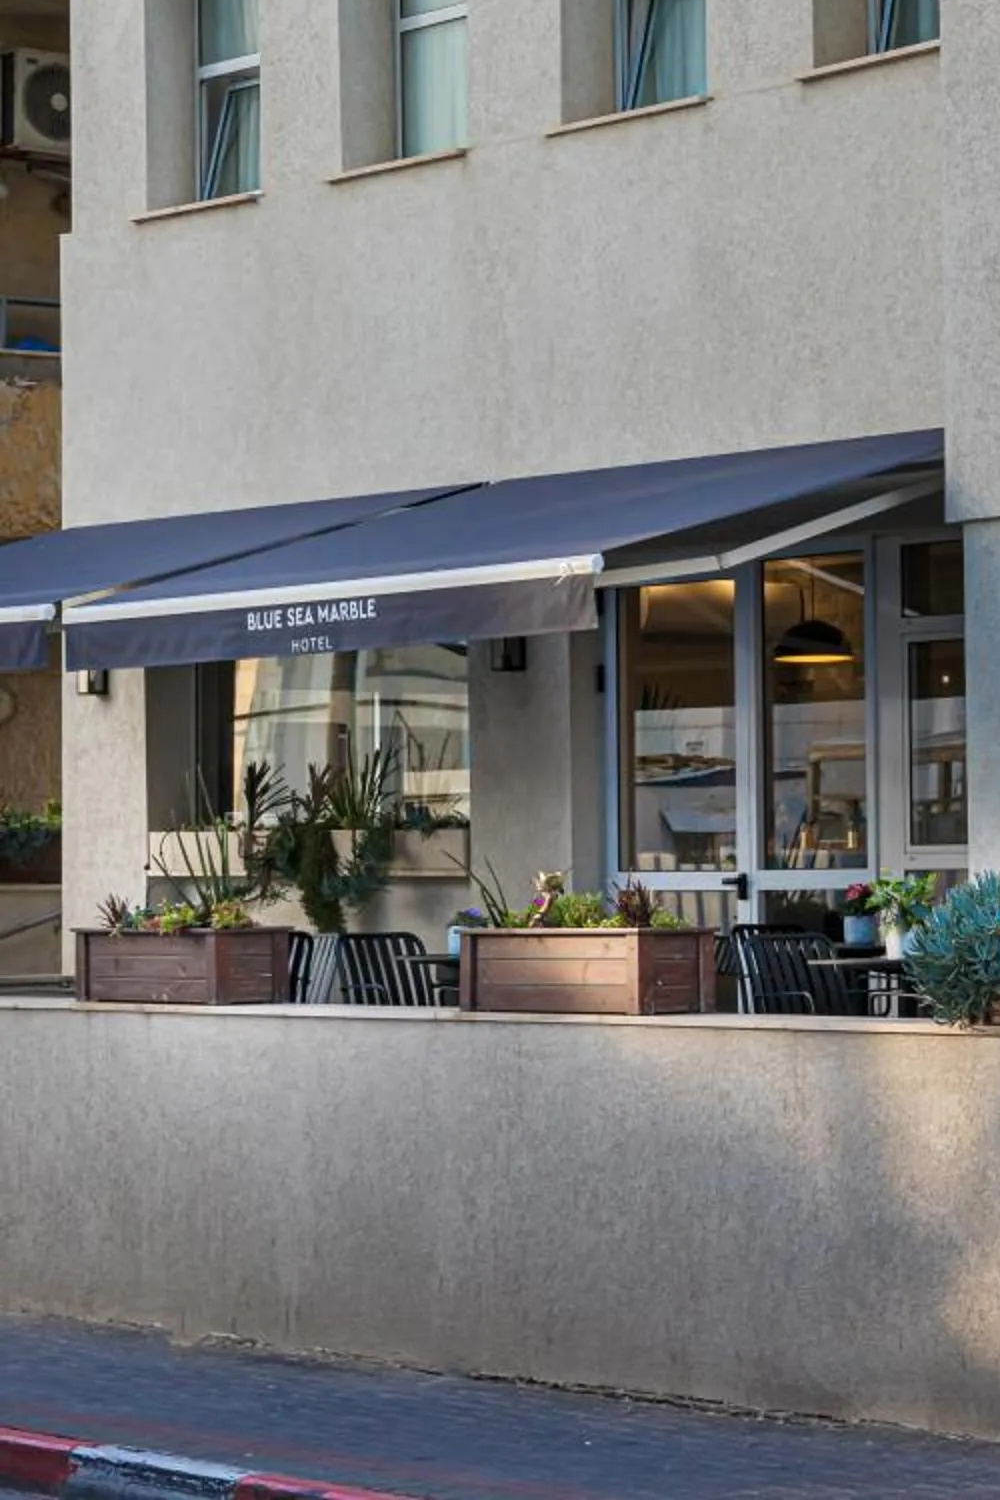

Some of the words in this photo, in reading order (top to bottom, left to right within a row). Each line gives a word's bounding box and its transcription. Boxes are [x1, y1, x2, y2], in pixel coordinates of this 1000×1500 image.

[247, 609, 283, 631] BLUE
[287, 606, 315, 627] SEA
[317, 598, 377, 623] MARBLE
[291, 635, 333, 653] HOTEL
